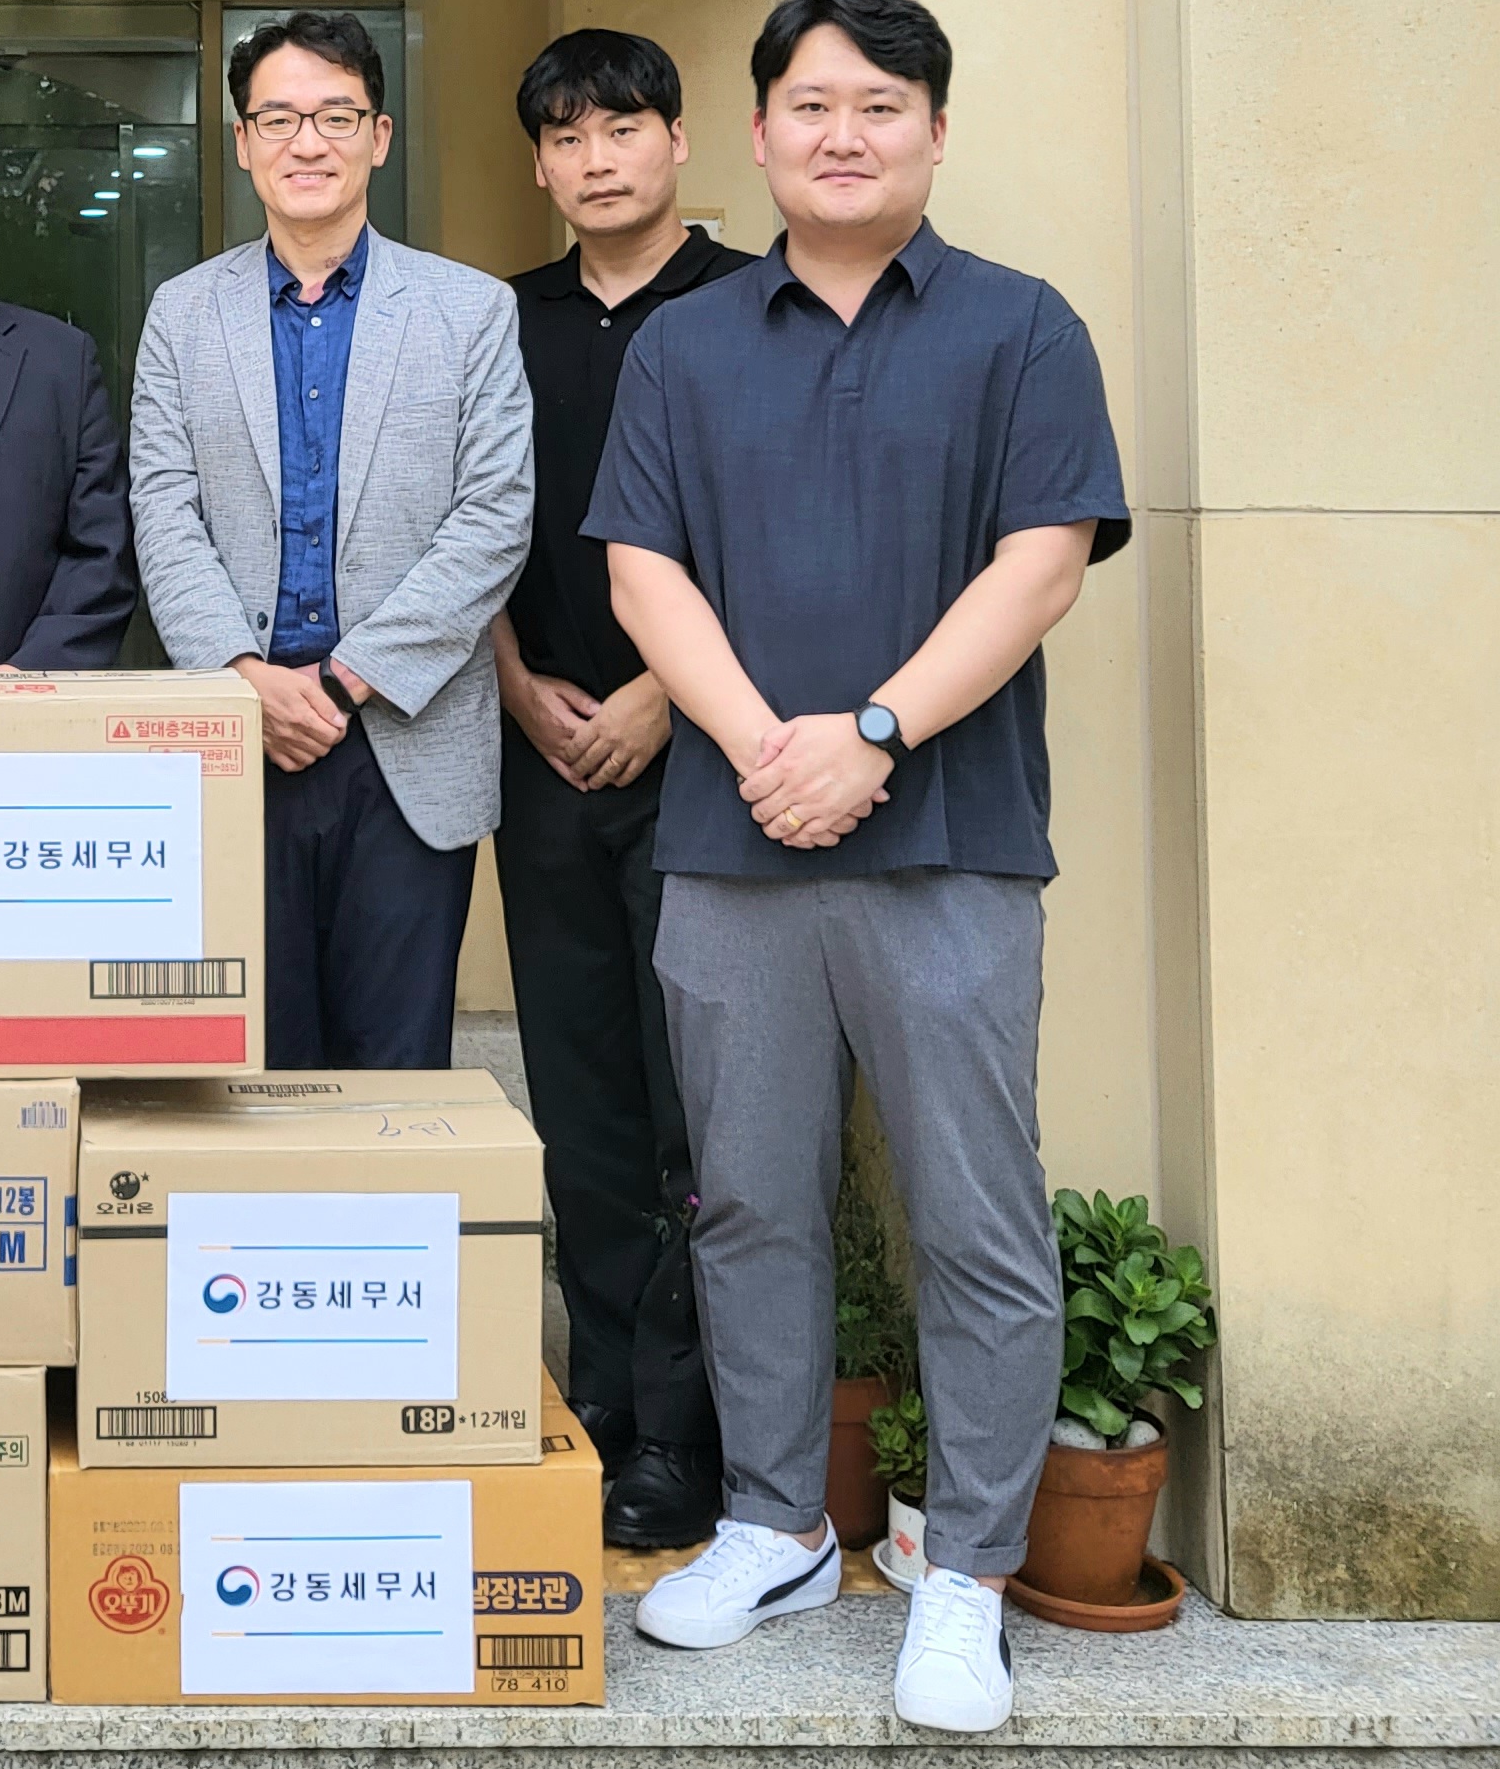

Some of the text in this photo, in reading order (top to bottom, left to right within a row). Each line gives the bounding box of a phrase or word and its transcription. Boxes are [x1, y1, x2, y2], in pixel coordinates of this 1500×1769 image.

[136, 721, 225, 737] 절대충격금지
[3, 840, 166, 869] 강동세무서
[96, 1202, 154, 1215] 오리온
[0, 1231, 25, 1263] M
[256, 1280, 423, 1309] 강동세무서
[136, 1391, 176, 1403] 1508
[405, 1407, 451, 1432] 18P
[270, 1571, 437, 1602] 강동세무서
[104, 1594, 156, 1615] 오뚜기
[496, 1677, 567, 1691] 78 410
